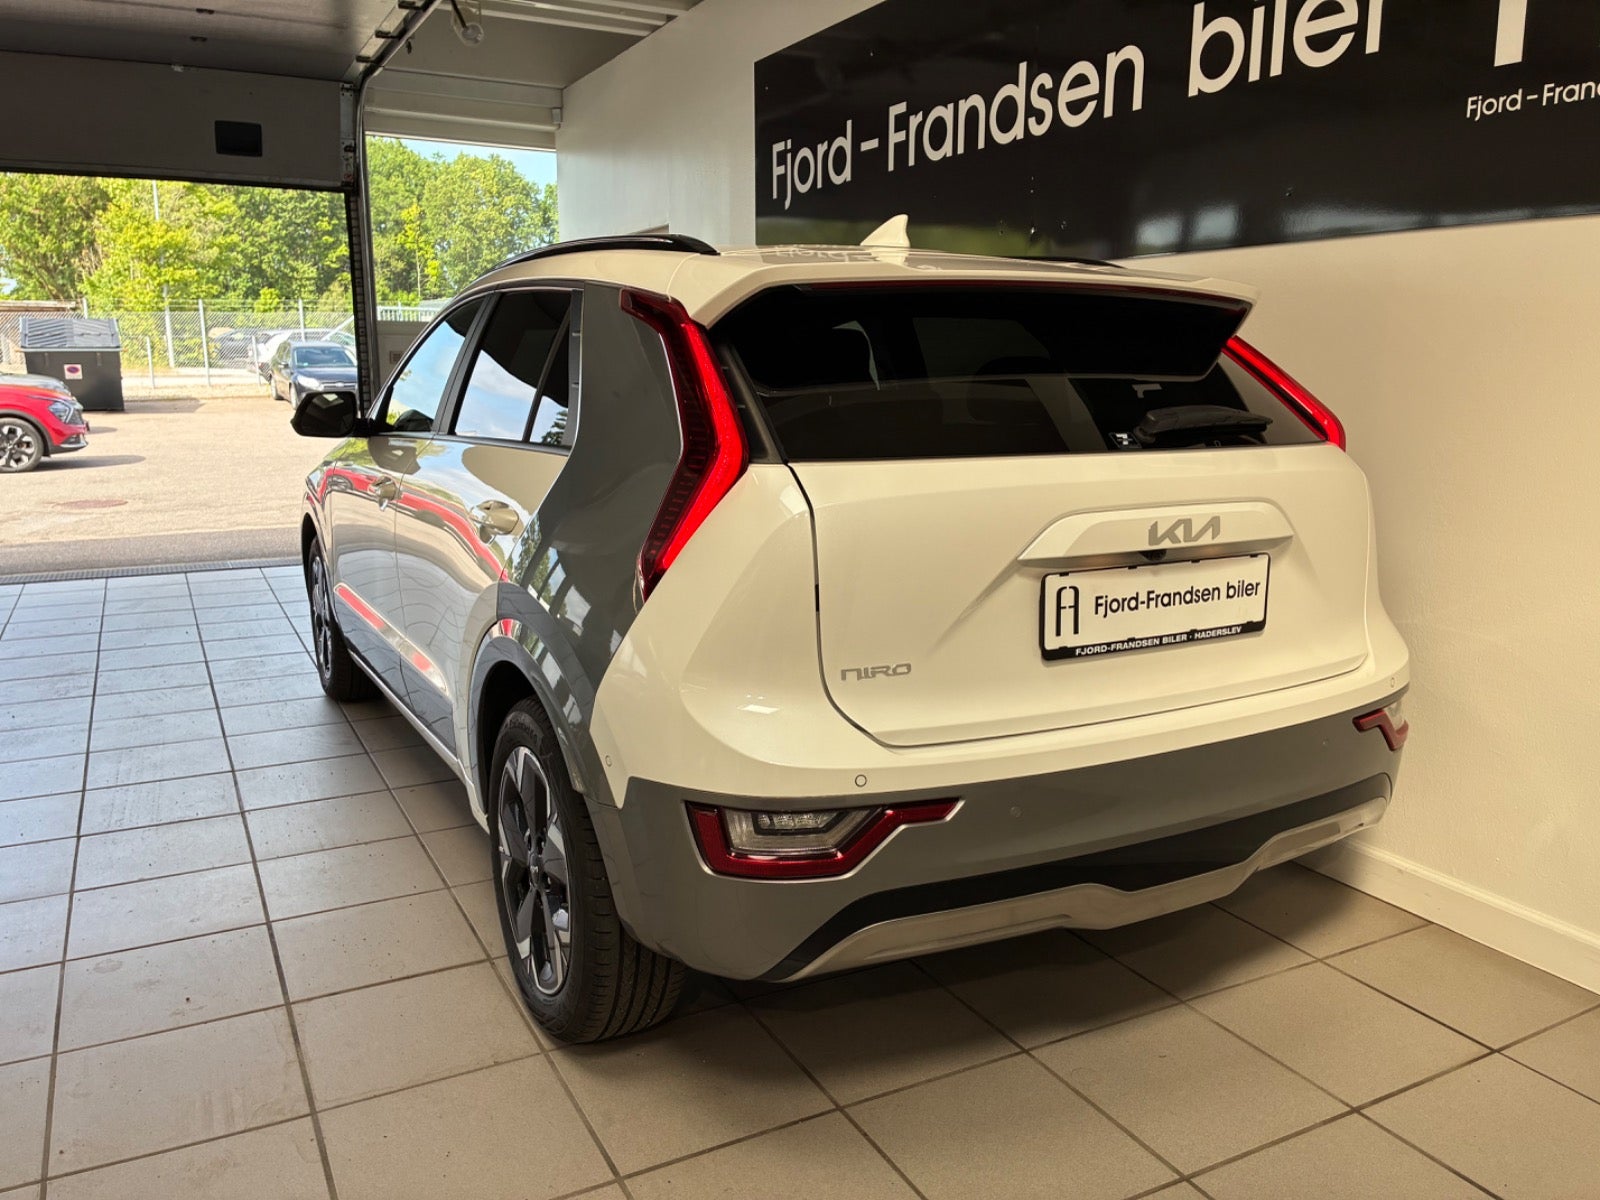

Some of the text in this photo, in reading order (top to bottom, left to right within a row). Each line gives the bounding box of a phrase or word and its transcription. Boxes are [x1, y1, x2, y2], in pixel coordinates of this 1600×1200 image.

[1094, 580, 1261, 618] Fjord-Frandsen biler
[1075, 626, 1242, 656] FJORD-FRANDSEN BILER HADERSLEV
